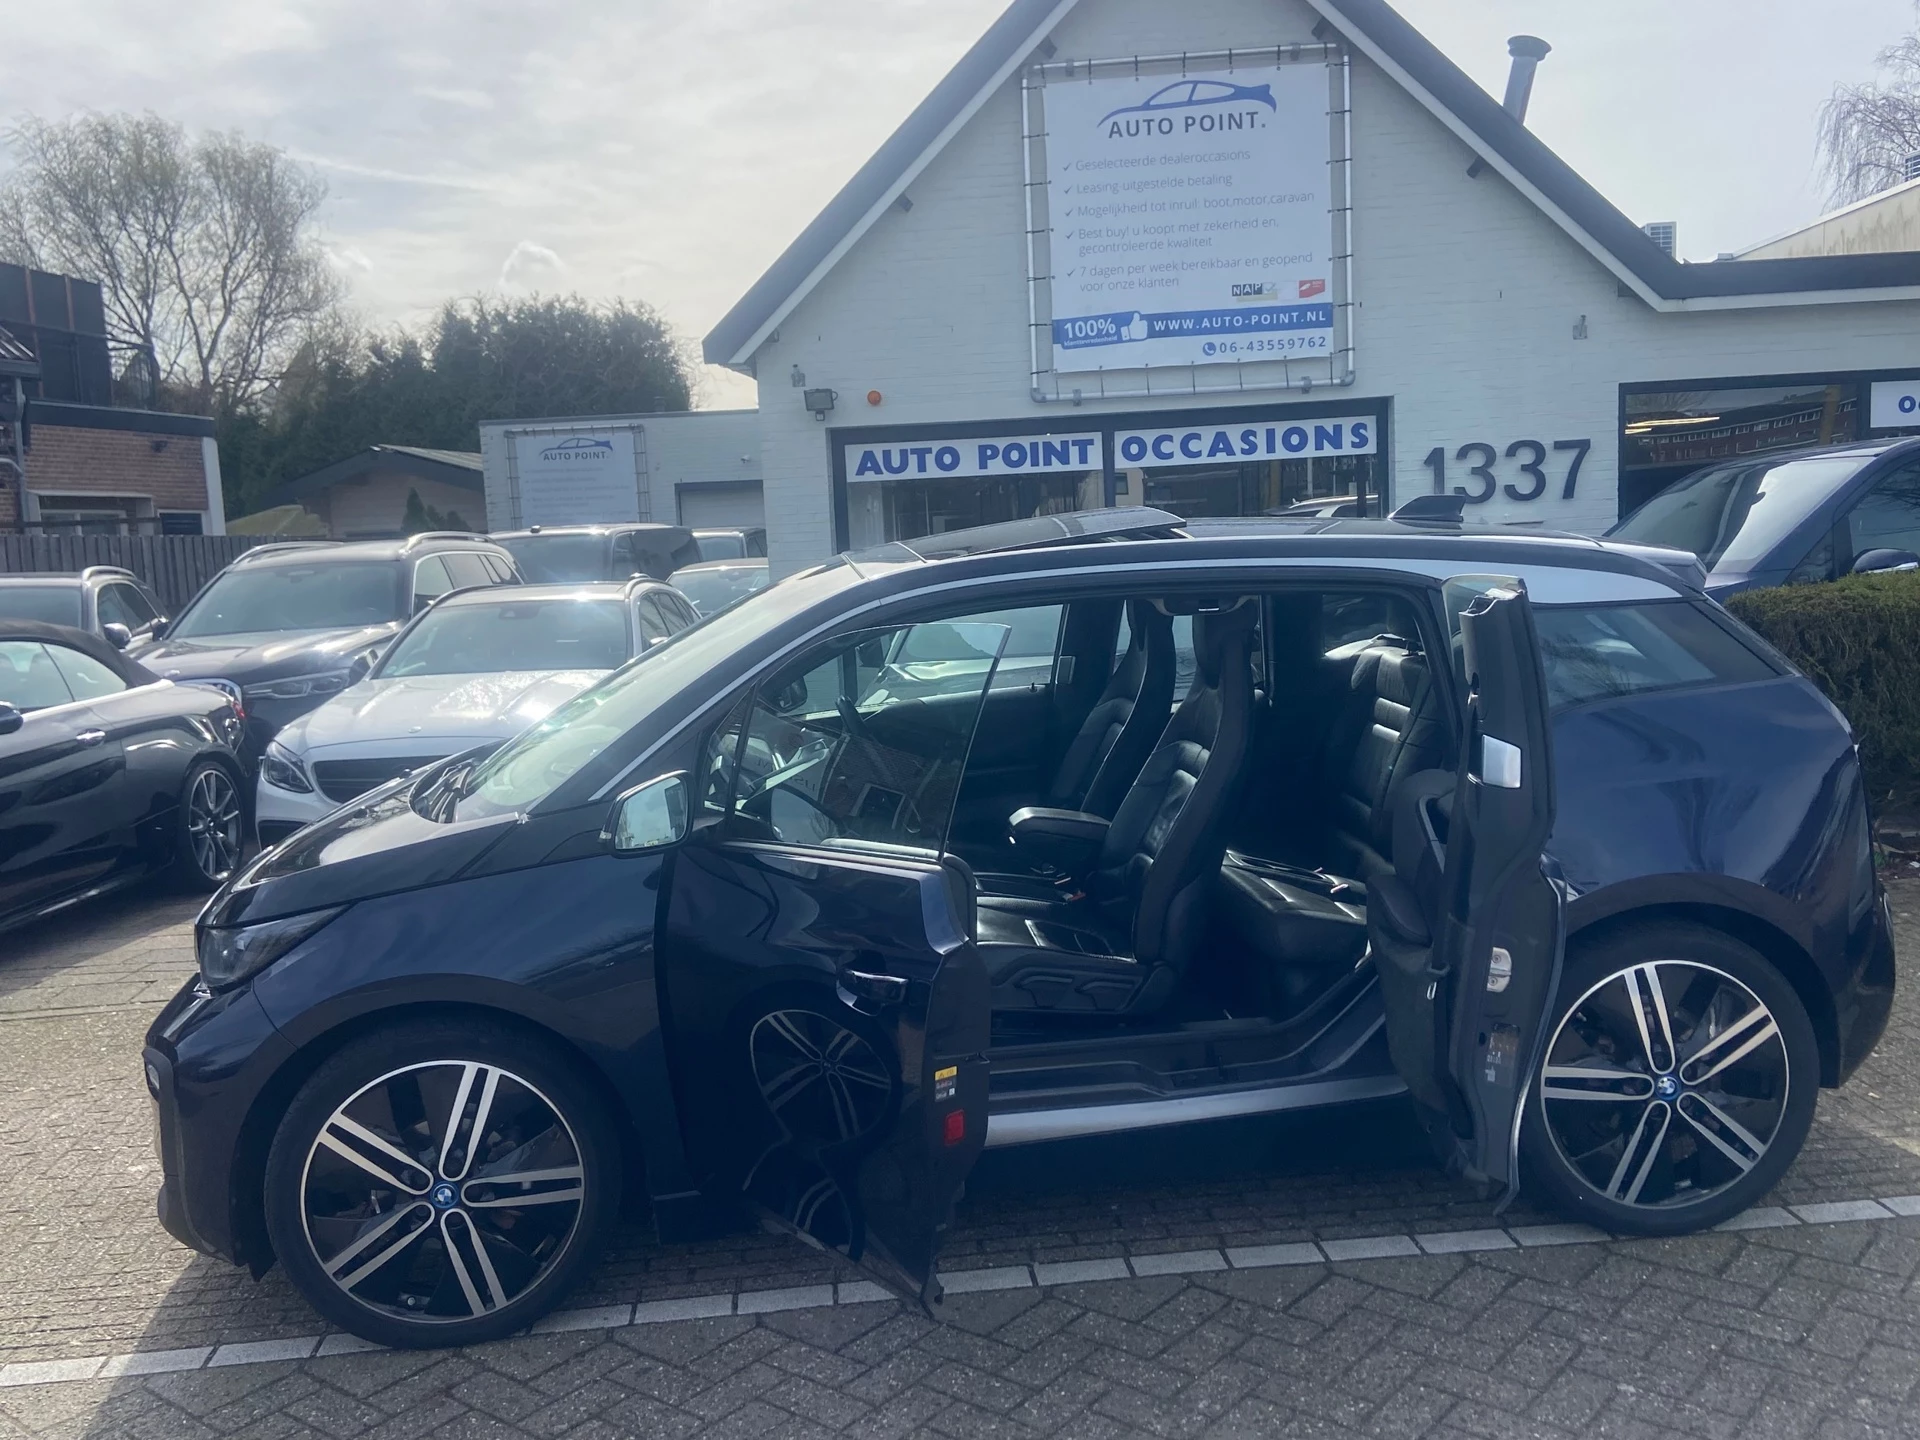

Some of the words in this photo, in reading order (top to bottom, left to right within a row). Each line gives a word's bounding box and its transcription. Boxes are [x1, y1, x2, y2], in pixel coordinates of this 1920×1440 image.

[1108, 117, 1174, 139] AUTO
[1075, 155, 1157, 172] Geselecteerde
[1159, 150, 1251, 166] dealeroccasions
[1187, 173, 1233, 187] betaling
[1077, 202, 1148, 219] Mogelijkheid
[1150, 200, 1167, 212] tot
[1078, 227, 1103, 240] Best
[1105, 224, 1130, 239] buy!
[1132, 226, 1141, 236] u
[1143, 222, 1175, 236] koopt
[1178, 221, 1200, 233] met
[1203, 217, 1260, 232] zekerheid
[1078, 239, 1165, 258] gecontroleerde
[1167, 235, 1213, 249] kwaliteit
[1079, 266, 1087, 277] 7
[1089, 264, 1125, 279] dagen
[1127, 264, 1147, 276] per
[1149, 259, 1179, 273] week
[1181, 255, 1241, 271] bereikbaar
[1244, 256, 1259, 267] en
[1261, 252, 1313, 269] geopend
[1080, 282, 1105, 292] voor
[1107, 279, 1135, 291] onze
[1138, 276, 1180, 289] klanten
[1232, 283, 1263, 297] NAP
[1063, 318, 1117, 339] 100%
[1153, 310, 1327, 332] WWW.AUTO-POINT.NL
[1219, 336, 1327, 354] 06-43559762
[543, 453, 571, 461] AUTO
[855, 446, 961, 476] AUTO
[977, 438, 1095, 470] POINT
[1121, 422, 1369, 462] OCCASIONS
[1423, 438, 1592, 505] 1337
